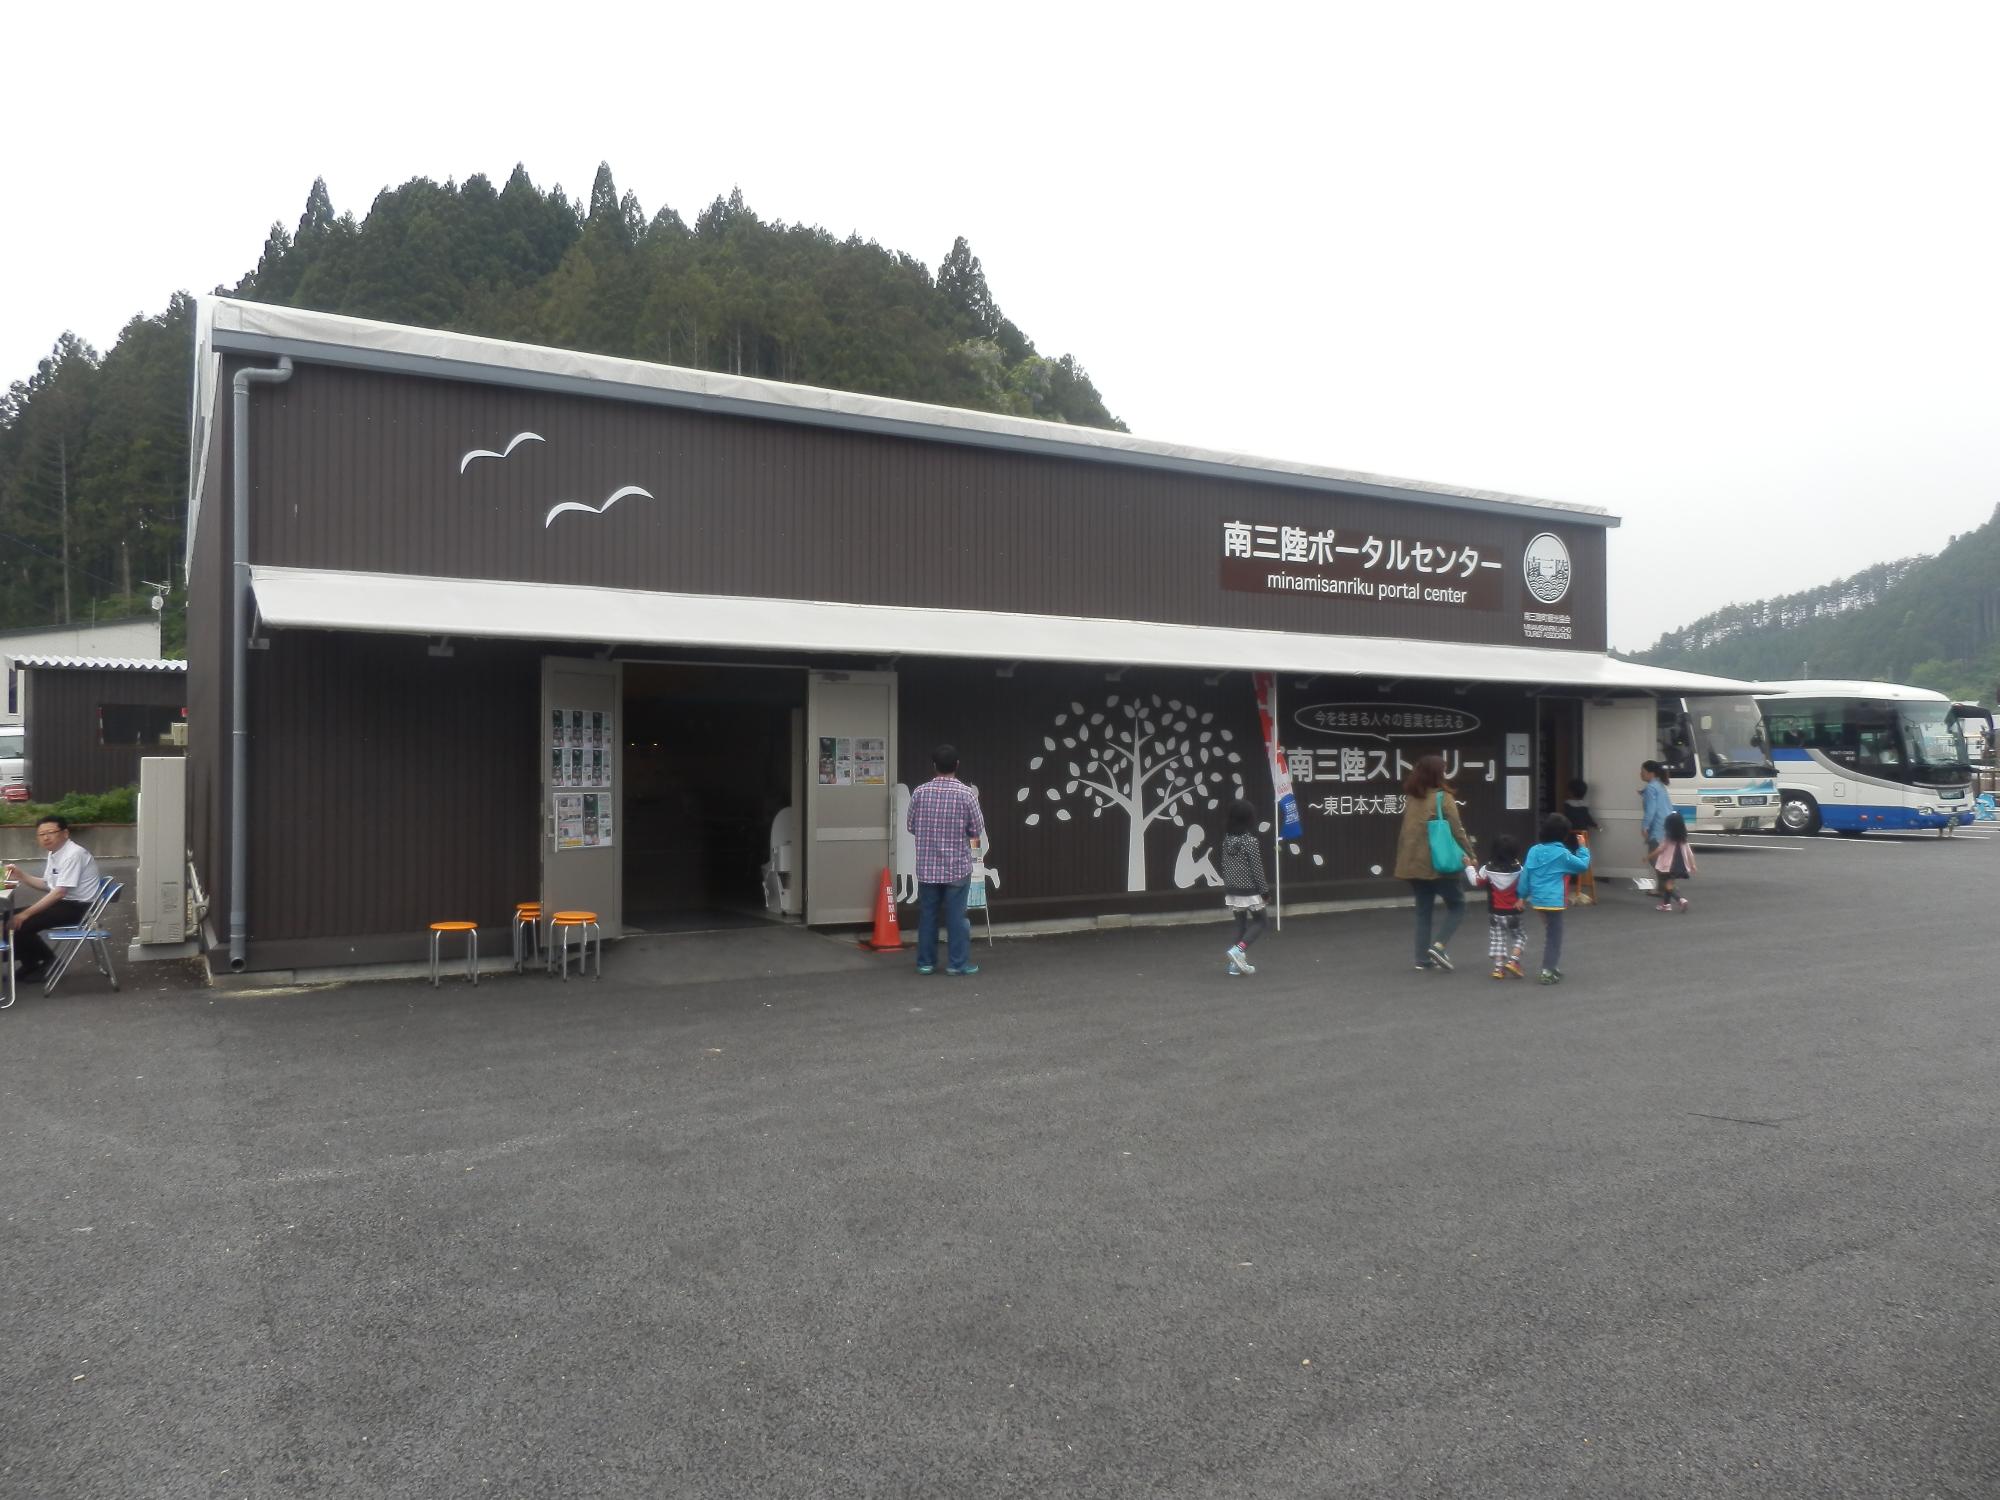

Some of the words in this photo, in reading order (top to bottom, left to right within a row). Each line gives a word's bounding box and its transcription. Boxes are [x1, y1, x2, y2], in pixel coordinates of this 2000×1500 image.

[1223, 520, 1503, 579] 南三陸ポータルセンター
[1267, 571, 1374, 596] minamisanriku
[1378, 581, 1420, 600] portal
[1424, 586, 1467, 604] center
[1279, 747, 1496, 783] 南三陸ストリー』
